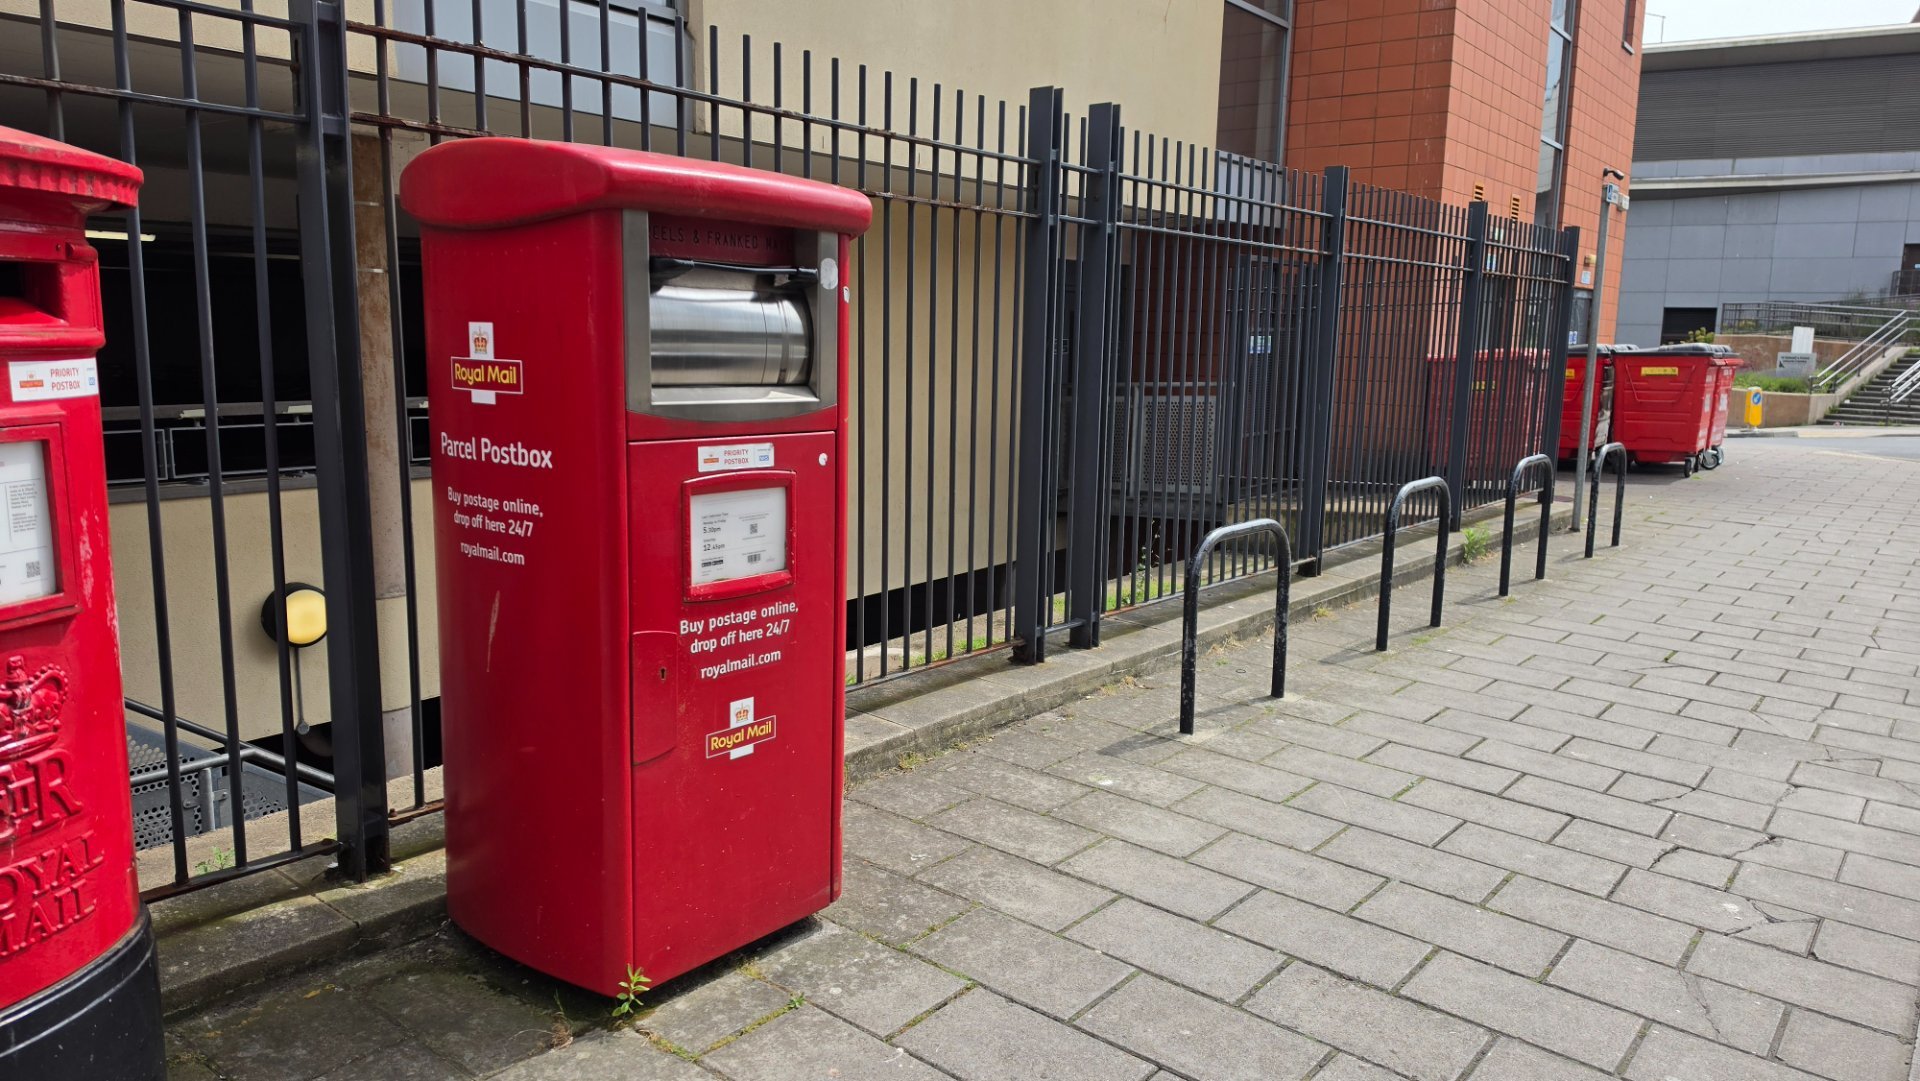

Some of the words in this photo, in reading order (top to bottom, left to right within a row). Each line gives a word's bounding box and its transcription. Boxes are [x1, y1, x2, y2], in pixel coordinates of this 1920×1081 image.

[649, 225, 684, 242] CELS
[692, 229, 700, 245] &
[707, 230, 758, 249] FRANKED
[50, 367, 79, 378] PRIORITY
[52, 380, 80, 391] POSTBOX
[454, 363, 484, 385] Royal
[487, 365, 517, 384] Mail
[441, 432, 477, 461] Parcel
[481, 437, 552, 469] Postbox
[724, 448, 749, 457] PRIORITY
[724, 457, 749, 465] POSTBOX
[447, 486, 462, 506] Buy
[463, 492, 499, 511] postage
[503, 499, 544, 517] online,
[454, 509, 470, 530] drop
[471, 511, 483, 529] off
[485, 514, 506, 533] here
[508, 519, 533, 537] 24/7
[460, 541, 525, 566] royalmail.com
[680, 619, 704, 635] Buy
[709, 609, 757, 630] postage
[761, 601, 799, 618] online,
[690, 638, 717, 653] drop
[720, 630, 736, 647] off
[739, 627, 763, 643] here
[766, 619, 790, 637] 24/7
[700, 650, 781, 679] royalmail.com
[711, 730, 745, 751] Royal
[747, 720, 772, 740] Mail
[0, 830, 105, 912] OYAL
